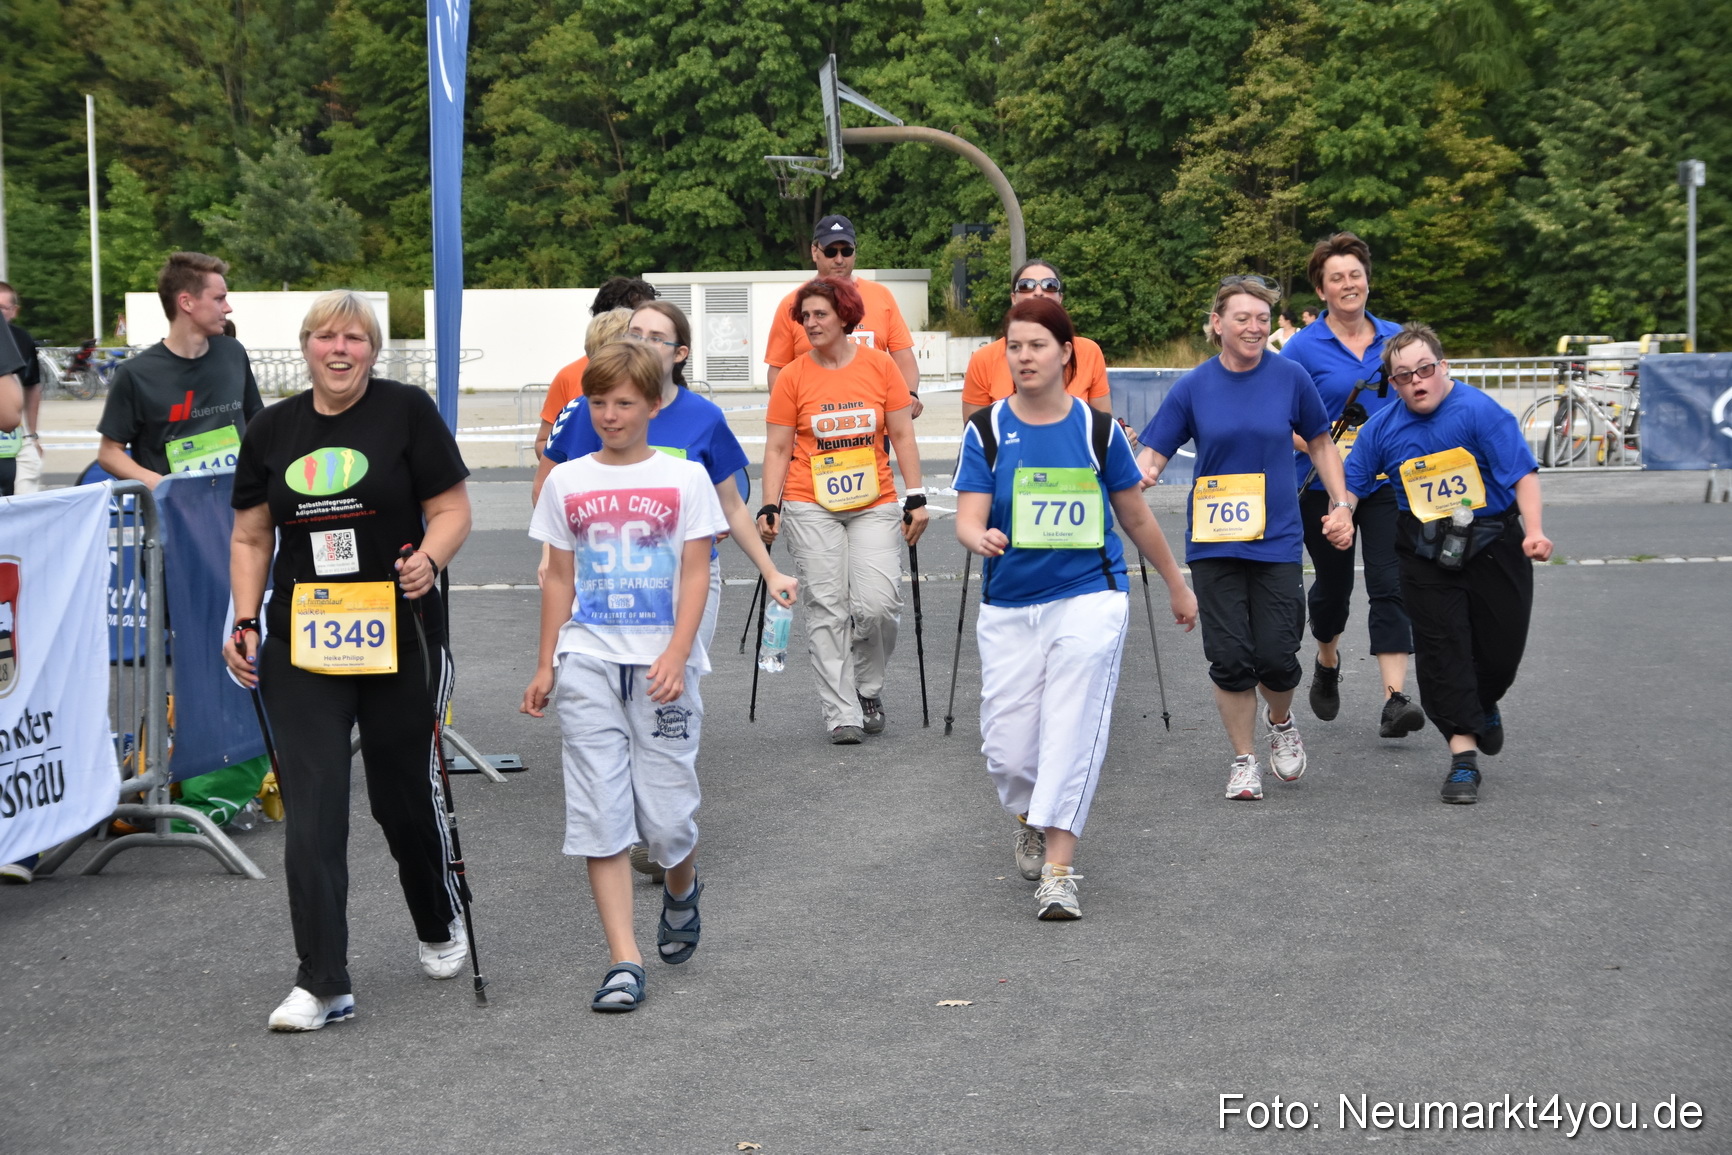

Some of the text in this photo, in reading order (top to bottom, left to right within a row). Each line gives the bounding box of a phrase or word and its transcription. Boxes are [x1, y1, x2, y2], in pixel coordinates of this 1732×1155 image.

[191, 400, 242, 418] duerrer.de
[820, 401, 864, 412] 30 Jahre
[817, 414, 871, 432] OBI
[816, 434, 875, 450] Neumarkt
[826, 472, 865, 496] 607
[1420, 475, 1468, 502] 743
[295, 502, 363, 516] Adipositas-Neumarkt
[569, 495, 672, 528] SANTA CRUZ
[1031, 500, 1085, 526] 770
[1206, 501, 1250, 524] 766
[587, 520, 653, 573] SC
[620, 576, 669, 590] PARADISE
[639, 610, 656, 618] MIND
[303, 619, 386, 649] 1349
